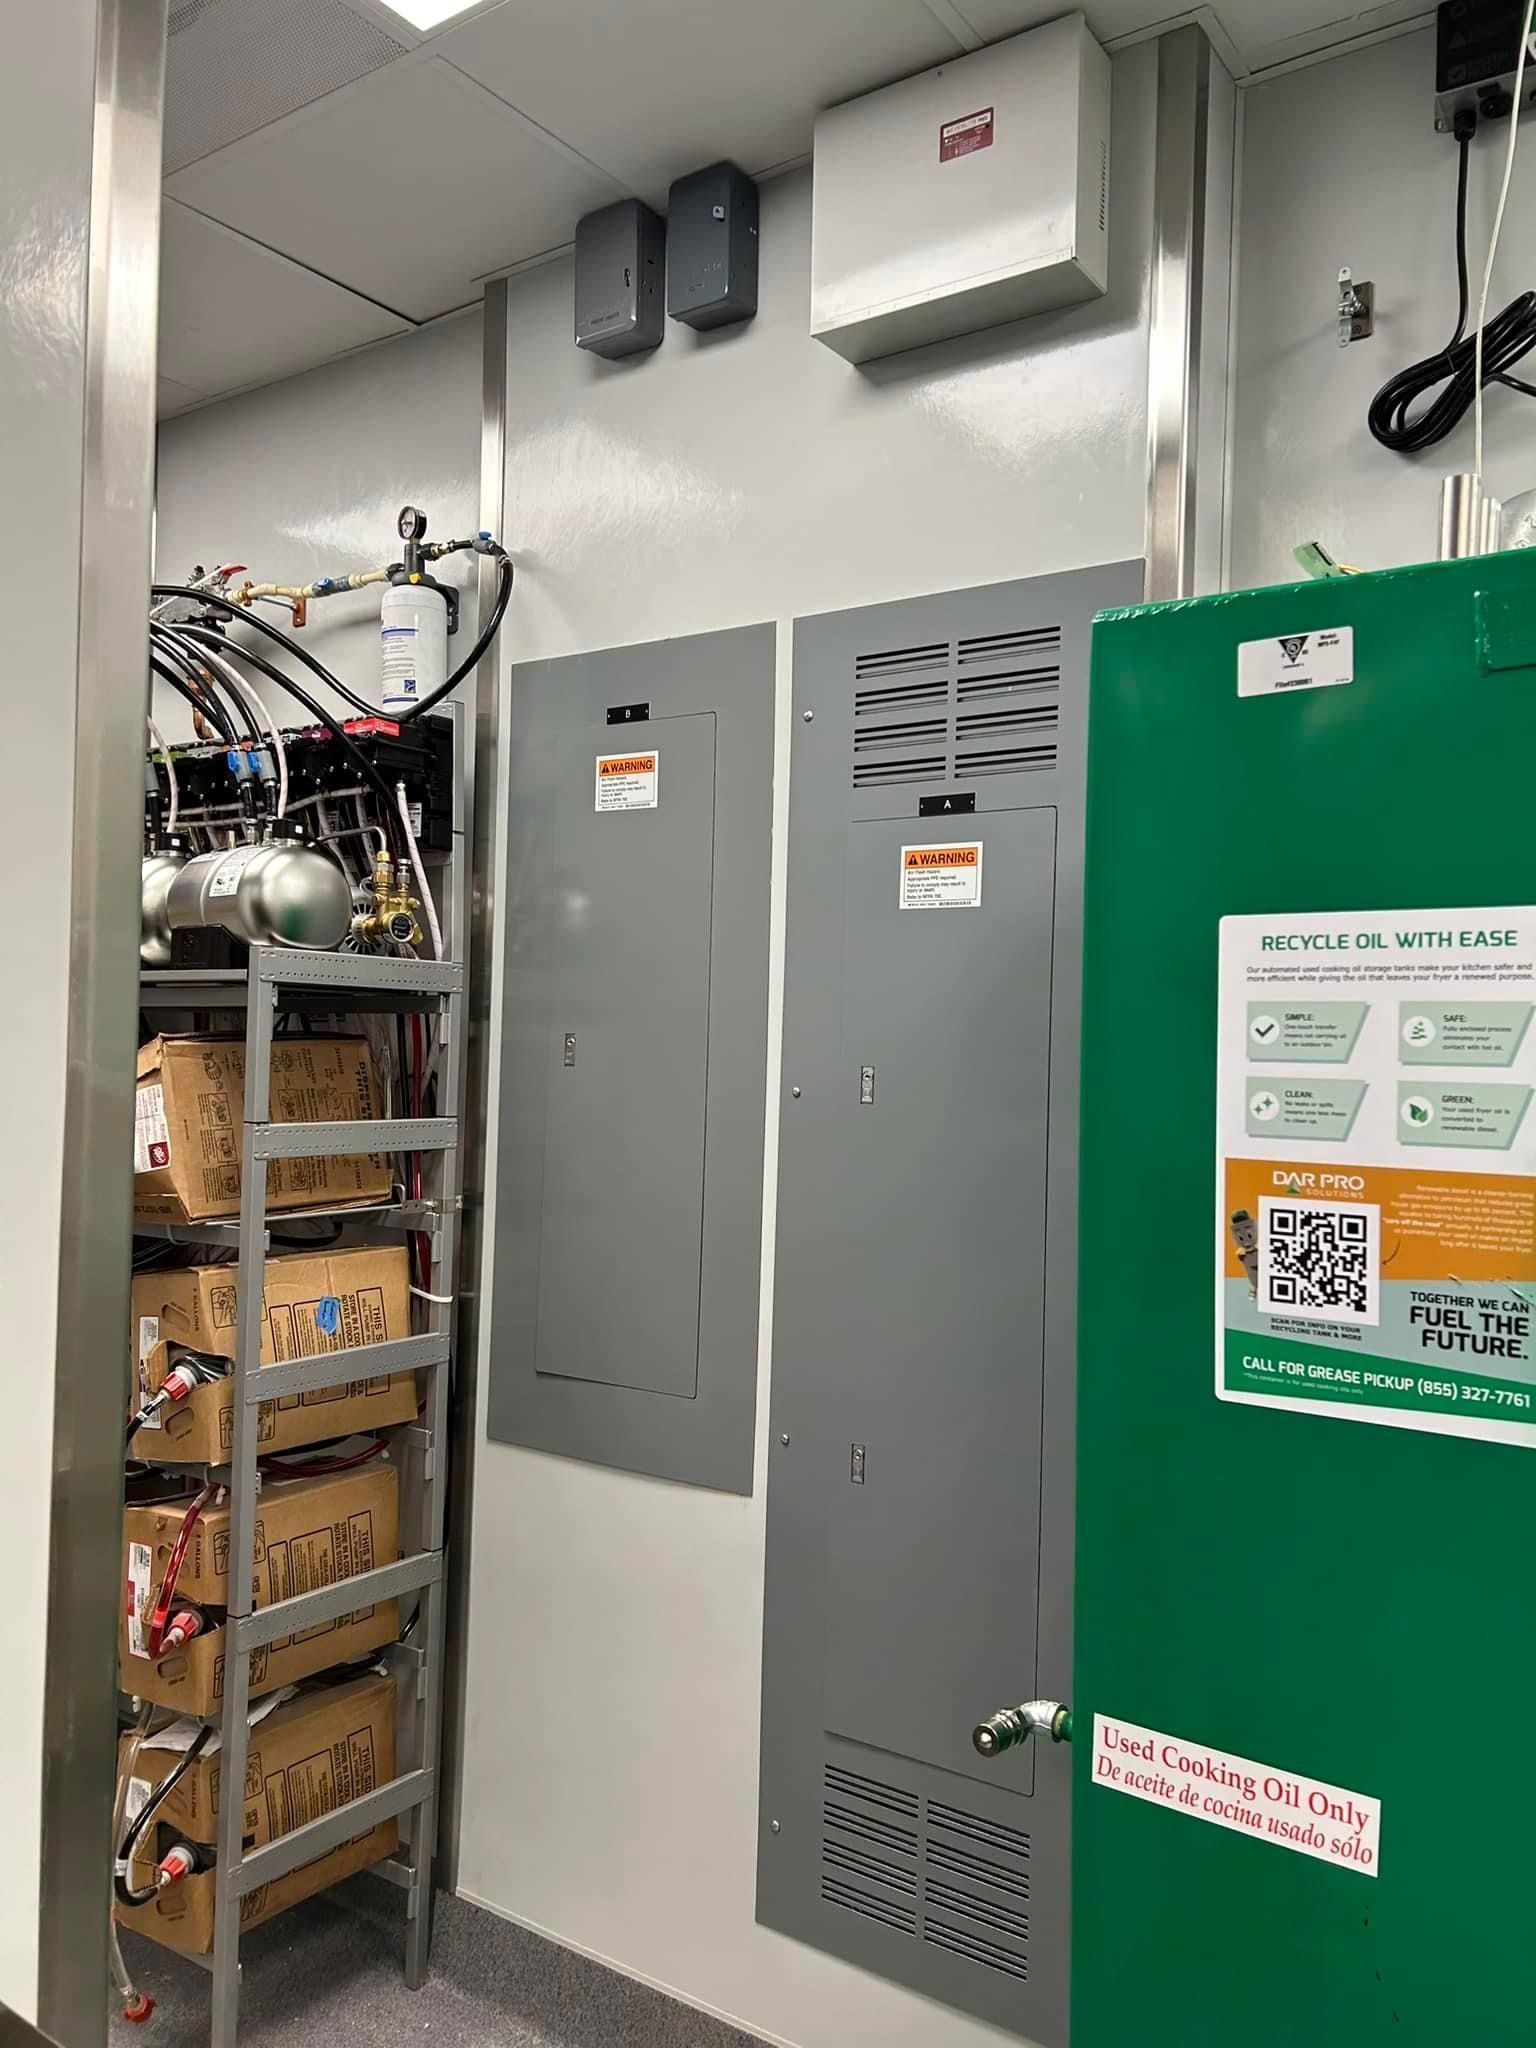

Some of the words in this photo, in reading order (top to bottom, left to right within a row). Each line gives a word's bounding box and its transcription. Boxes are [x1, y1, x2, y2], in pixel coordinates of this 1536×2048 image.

[625, 709, 631, 718] B
[610, 760, 653, 773] WARNING
[944, 800, 952, 809] A
[920, 852, 975, 865] WARNING
[1261, 934, 1350, 951] RECYCLE
[1355, 933, 1388, 950] OIL
[1396, 932, 1452, 948] WITH
[1460, 930, 1518, 947] EASE
[1284, 1013, 1314, 1022] SIMPLE:
[1442, 1014, 1468, 1023] SAFE:
[1284, 1090, 1313, 1098] CLEAN:
[1441, 1095, 1475, 1104] GREEN:
[1272, 1170, 1316, 1188] DAR
[1320, 1173, 1365, 1191] PRO
[1306, 1188, 1365, 1199] SOLUTIONS
[1410, 1290, 1475, 1308] TOGETHER
[1478, 1296, 1500, 1310] WE
[1502, 1299, 1530, 1314] CAN
[372, 1306, 382, 1330] THIS
[1410, 1305, 1472, 1332] FUEL
[1479, 1312, 1530, 1337] THE
[1271, 1324, 1311, 1335] RECYCLING
[1312, 1330, 1332, 1338] TANK
[1307, 1322, 1326, 1330] INFO
[1340, 1326, 1361, 1334] YOUR
[1422, 1328, 1530, 1360] FUTURE.
[1242, 1356, 1276, 1372] CALL
[1278, 1360, 1305, 1377] FOR
[1308, 1364, 1361, 1384] GREASE
[1364, 1372, 1414, 1393] PICKUP
[1417, 1376, 1458, 1401] (855)
[1461, 1384, 1531, 1408] 327-7761
[362, 1530, 370, 1556] THIS
[362, 1746, 371, 1772] THIS
[1102, 1726, 1154, 1762] Used
[1162, 1746, 1256, 1801] Cooking
[1263, 1777, 1300, 1808] Oil
[1308, 1790, 1371, 1835] Only
[1096, 1754, 1121, 1781] De
[1124, 1770, 1175, 1800] aceite
[1178, 1782, 1200, 1808] de
[1203, 1796, 1263, 1829] cocina
[1268, 1815, 1326, 1849] usado
[1330, 1836, 1373, 1865] sólo
